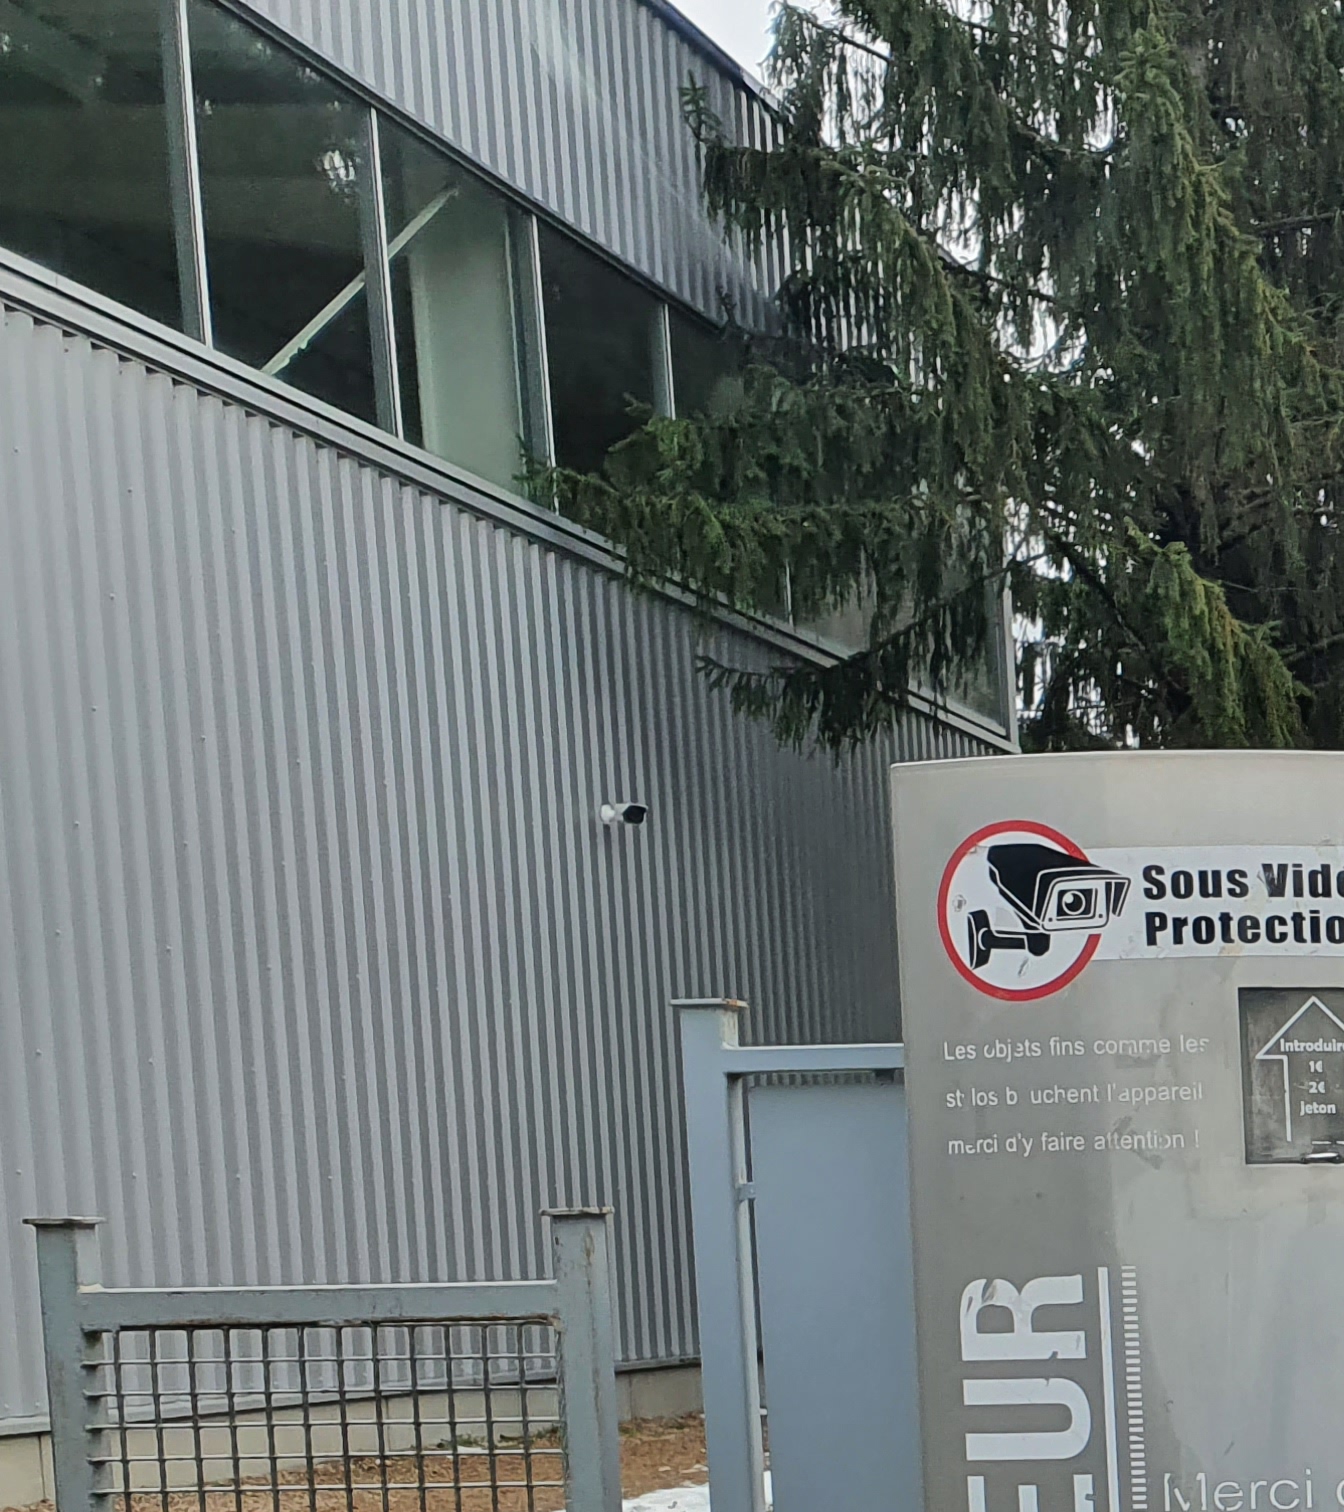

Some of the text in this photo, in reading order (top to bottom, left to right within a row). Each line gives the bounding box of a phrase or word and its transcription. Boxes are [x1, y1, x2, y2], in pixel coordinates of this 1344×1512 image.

[1142, 864, 1248, 900] Sous
[943, 1042, 976, 1060] Les
[1049, 1037, 1085, 1056] fins
[1093, 1037, 1171, 1055] comme
[1309, 1061, 1323, 1072] 1€
[1308, 1081, 1325, 1093] 2€
[1041, 1132, 1085, 1151] faire
[1164, 1468, 1313, 1512] Merci
